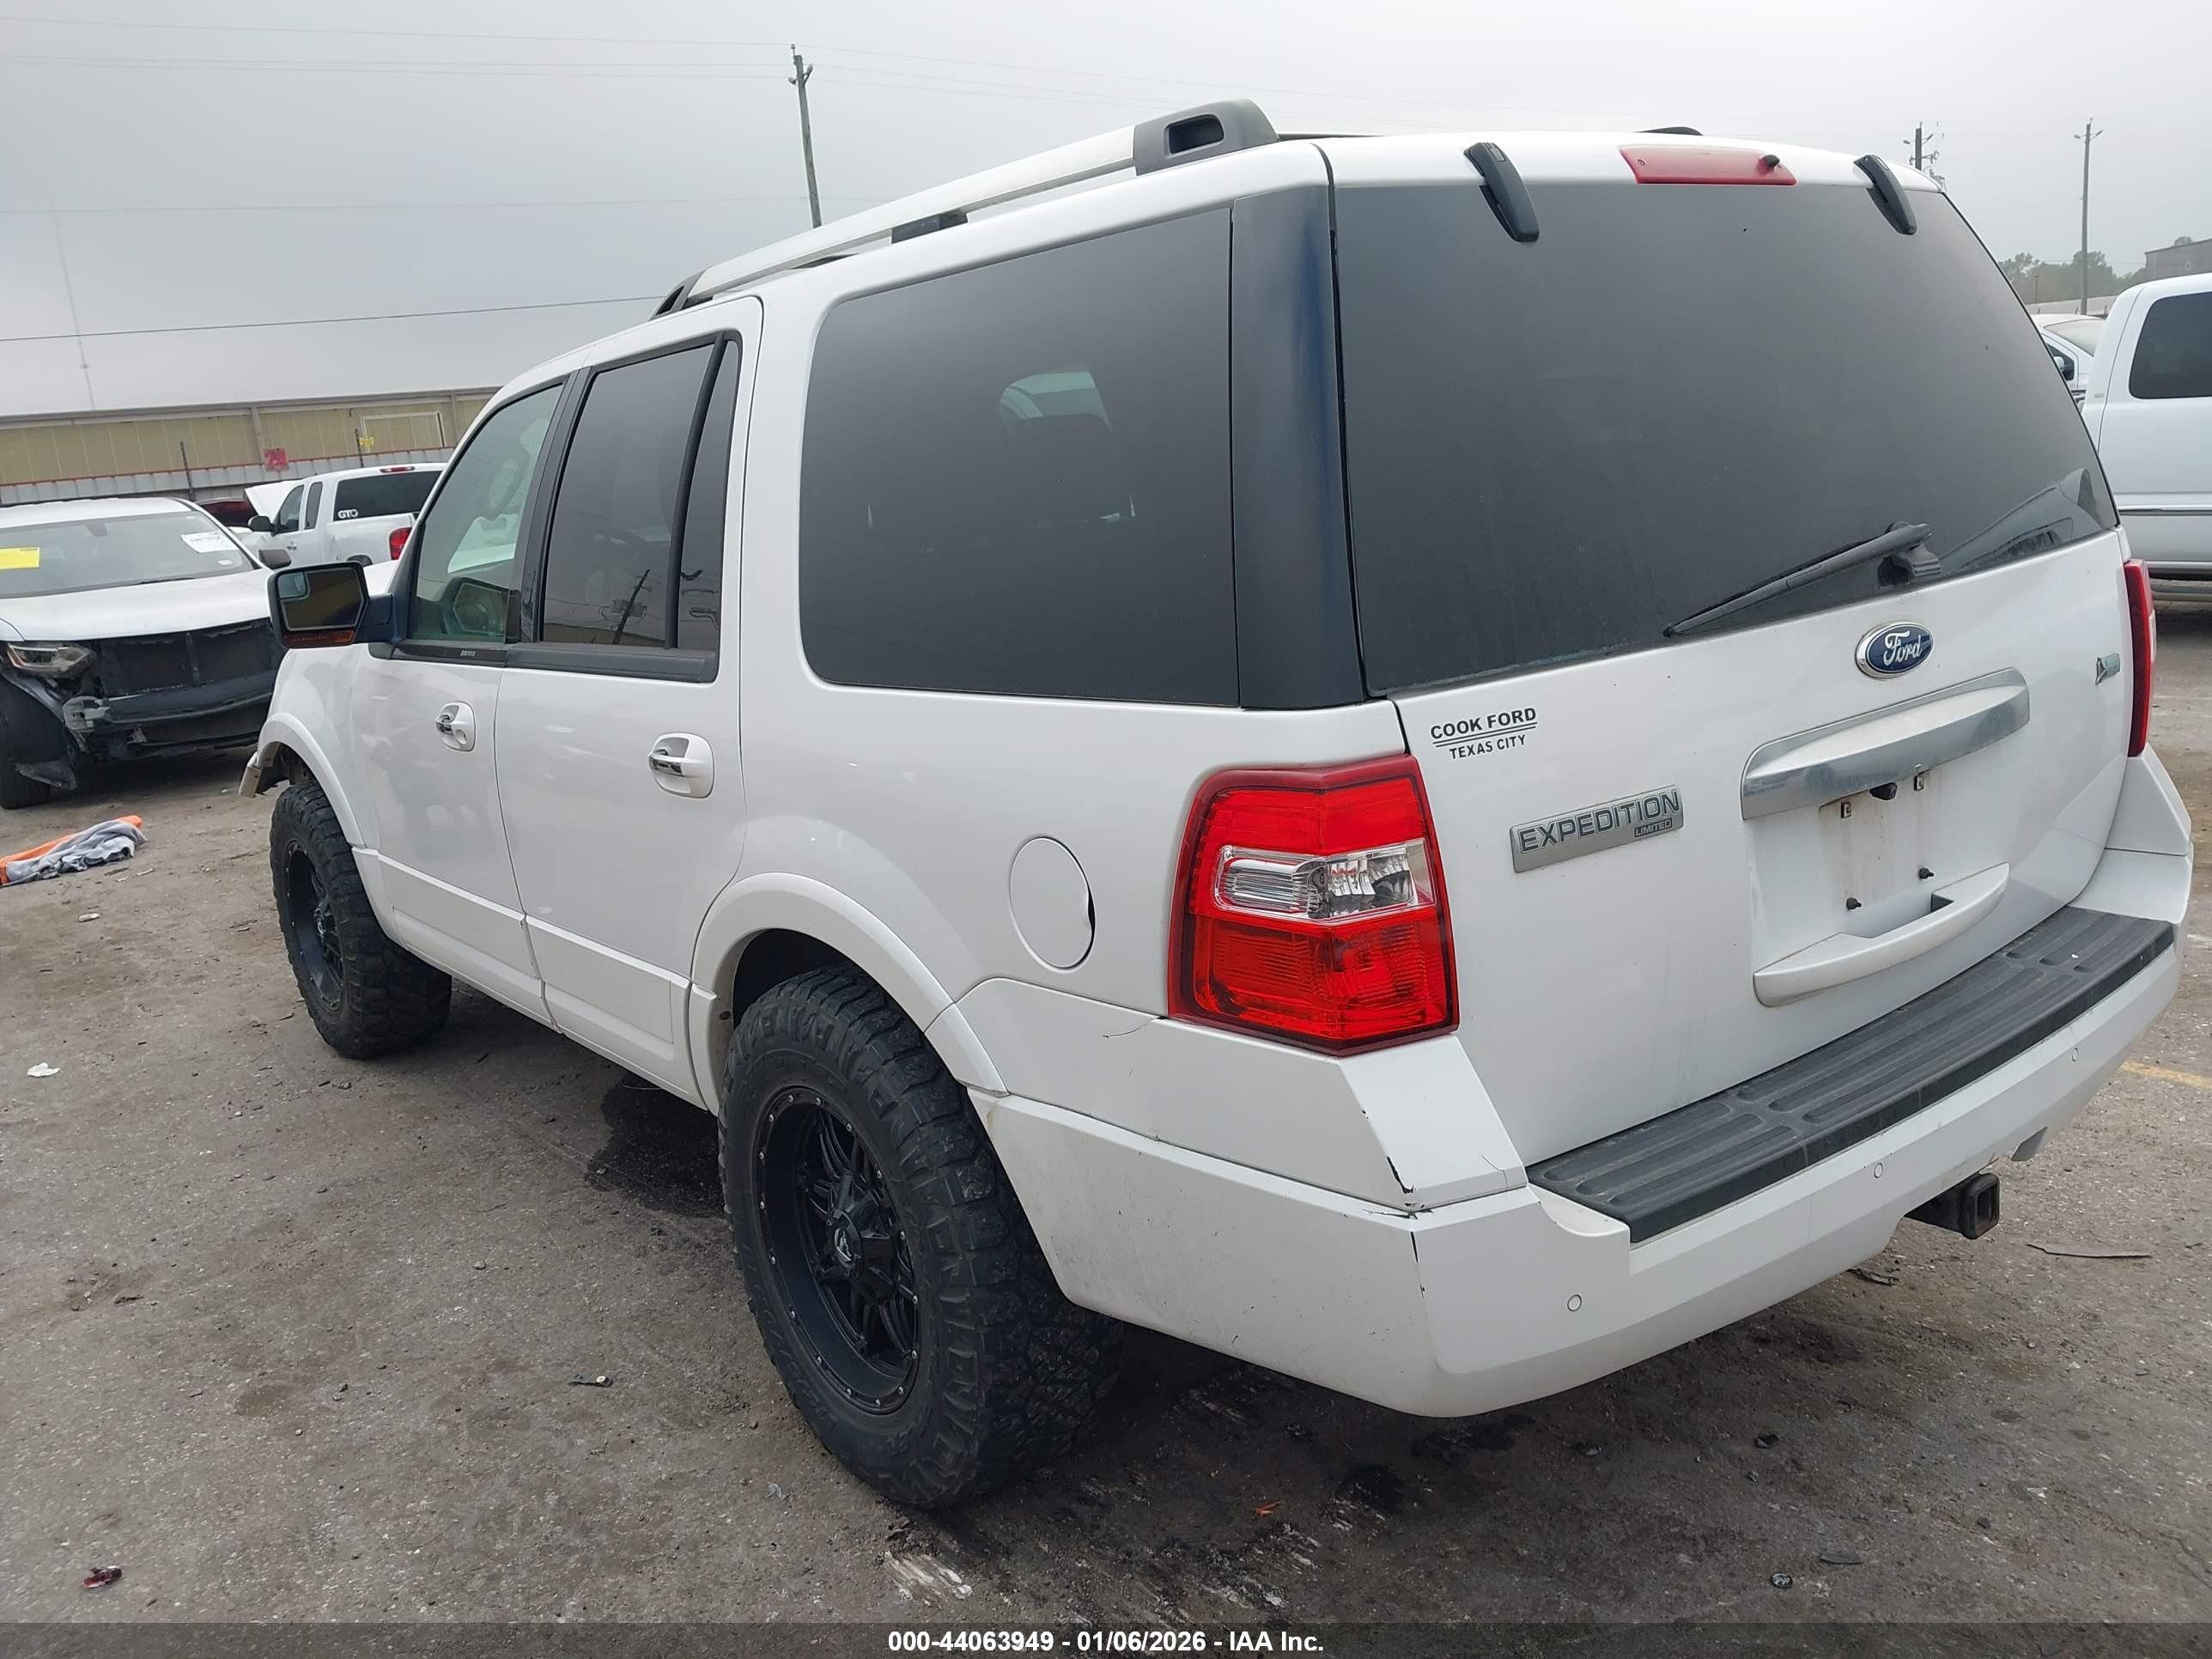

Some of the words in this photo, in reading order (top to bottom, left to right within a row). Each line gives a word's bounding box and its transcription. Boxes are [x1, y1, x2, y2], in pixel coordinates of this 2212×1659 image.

[1883, 630, 1923, 666] Ford
[1430, 717, 1482, 739] COOK
[1486, 707, 1536, 729] FORD
[1449, 740, 1493, 760] TEXAS
[1497, 734, 1526, 750] CITY
[1518, 788, 1680, 854] EXPEDITION
[1634, 818, 1673, 838] LIMITED
